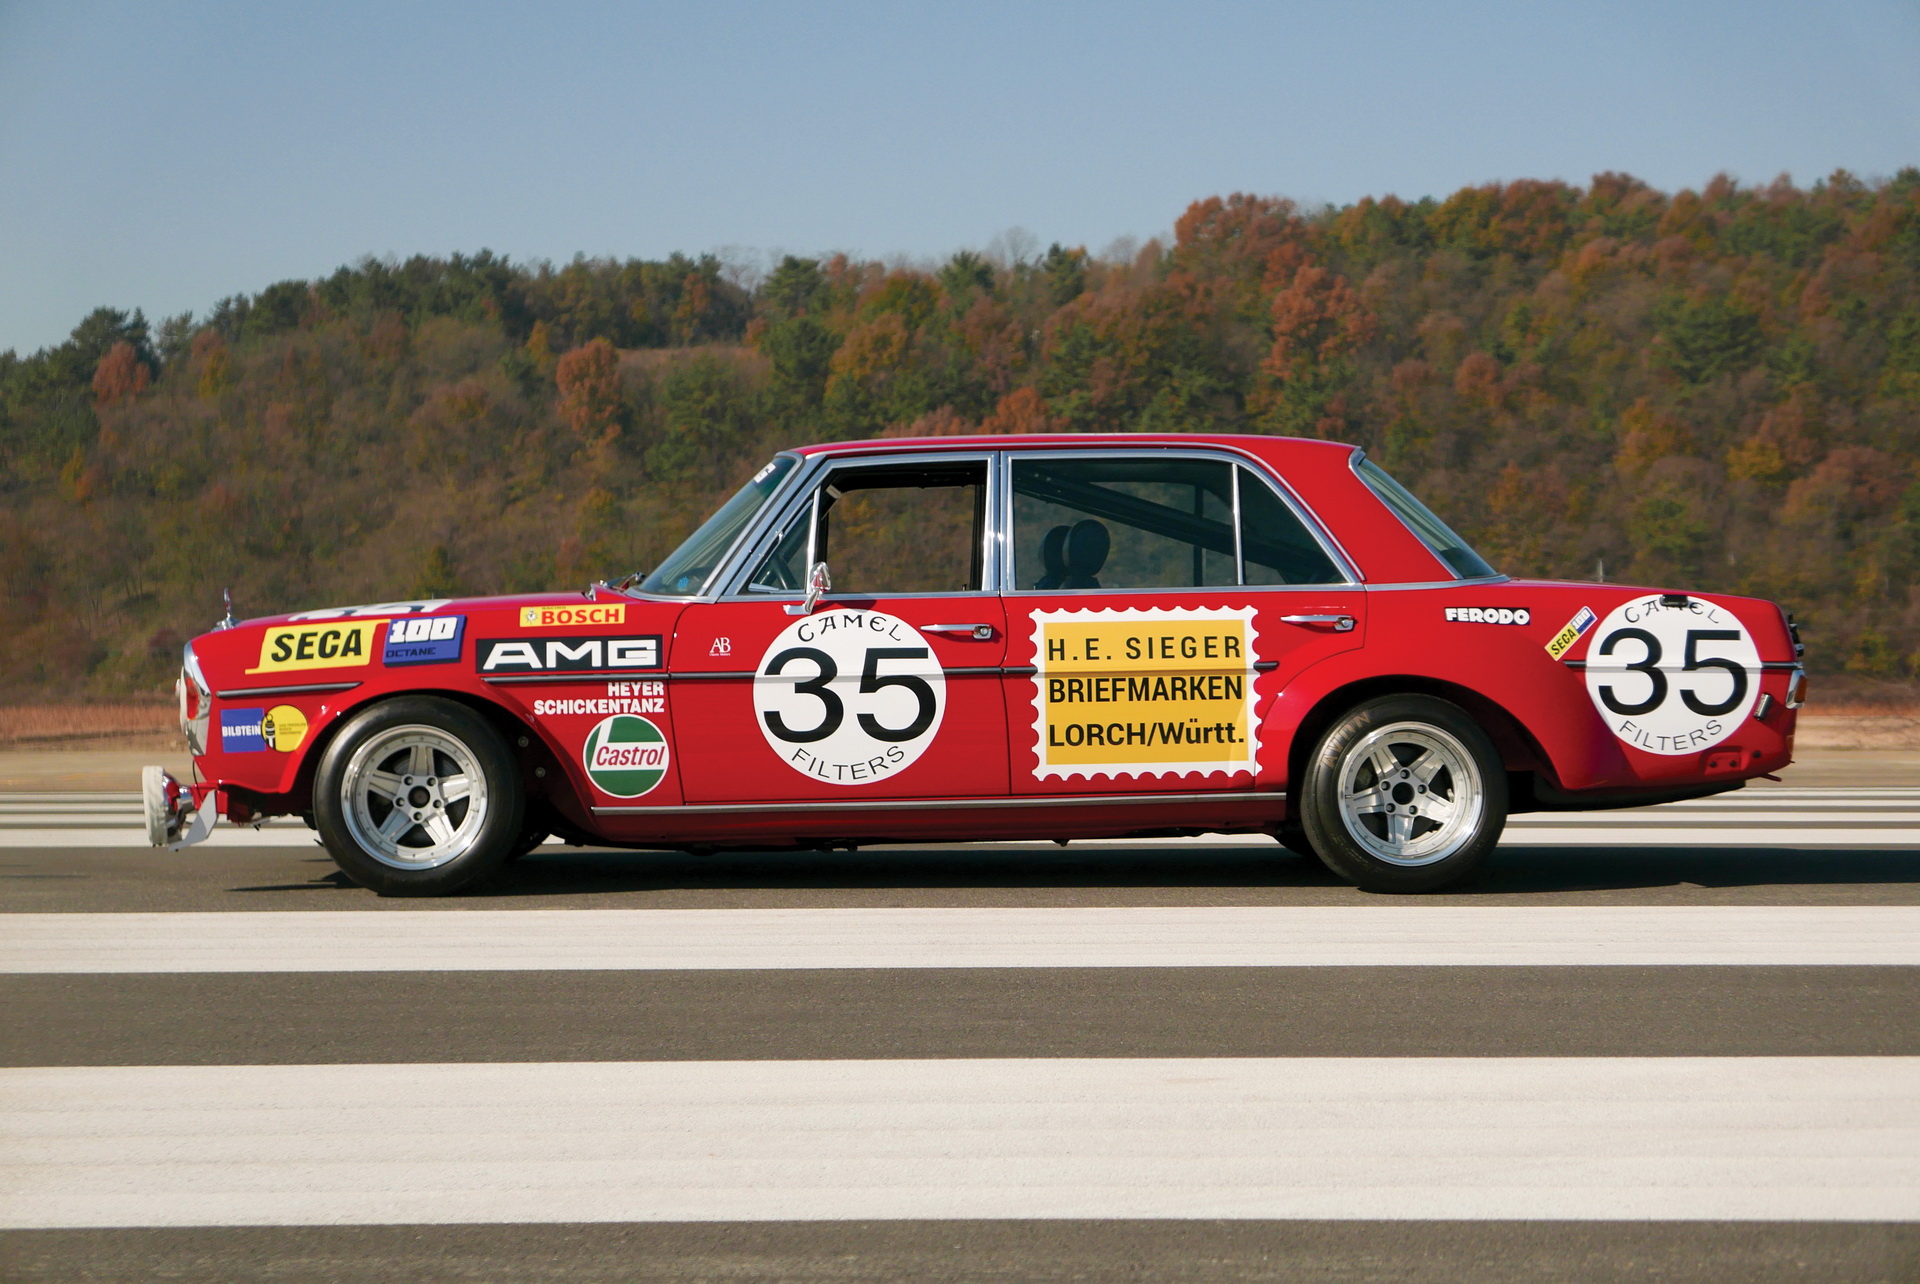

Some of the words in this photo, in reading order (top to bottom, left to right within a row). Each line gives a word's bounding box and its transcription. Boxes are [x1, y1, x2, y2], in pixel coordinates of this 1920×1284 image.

[541, 608, 620, 625] BOSCH
[1445, 608, 1530, 625] FERODO
[1625, 599, 1719, 624] CAEL
[271, 629, 362, 662] SECA
[389, 617, 458, 644] 100
[797, 614, 902, 642] CAMEL
[385, 647, 437, 658] OCTANE
[482, 639, 657, 670] AMG
[709, 636, 732, 653] AB
[1048, 637, 1112, 661] H.E.
[1126, 635, 1241, 659] SIEGER
[1551, 628, 1576, 655] SECA
[1598, 627, 1748, 716] 35
[608, 682, 664, 696] HEYER
[763, 646, 937, 743] 35
[1049, 676, 1243, 703] BRIEFMARKEN
[533, 698, 665, 715] SCHICKENTANZ
[221, 725, 261, 737] BILSTEIN
[1049, 718, 1245, 747] LORCH/Württ.
[1619, 719, 1723, 751] FILTERS
[596, 746, 666, 766] Castrol
[791, 745, 905, 780] FILTERS
